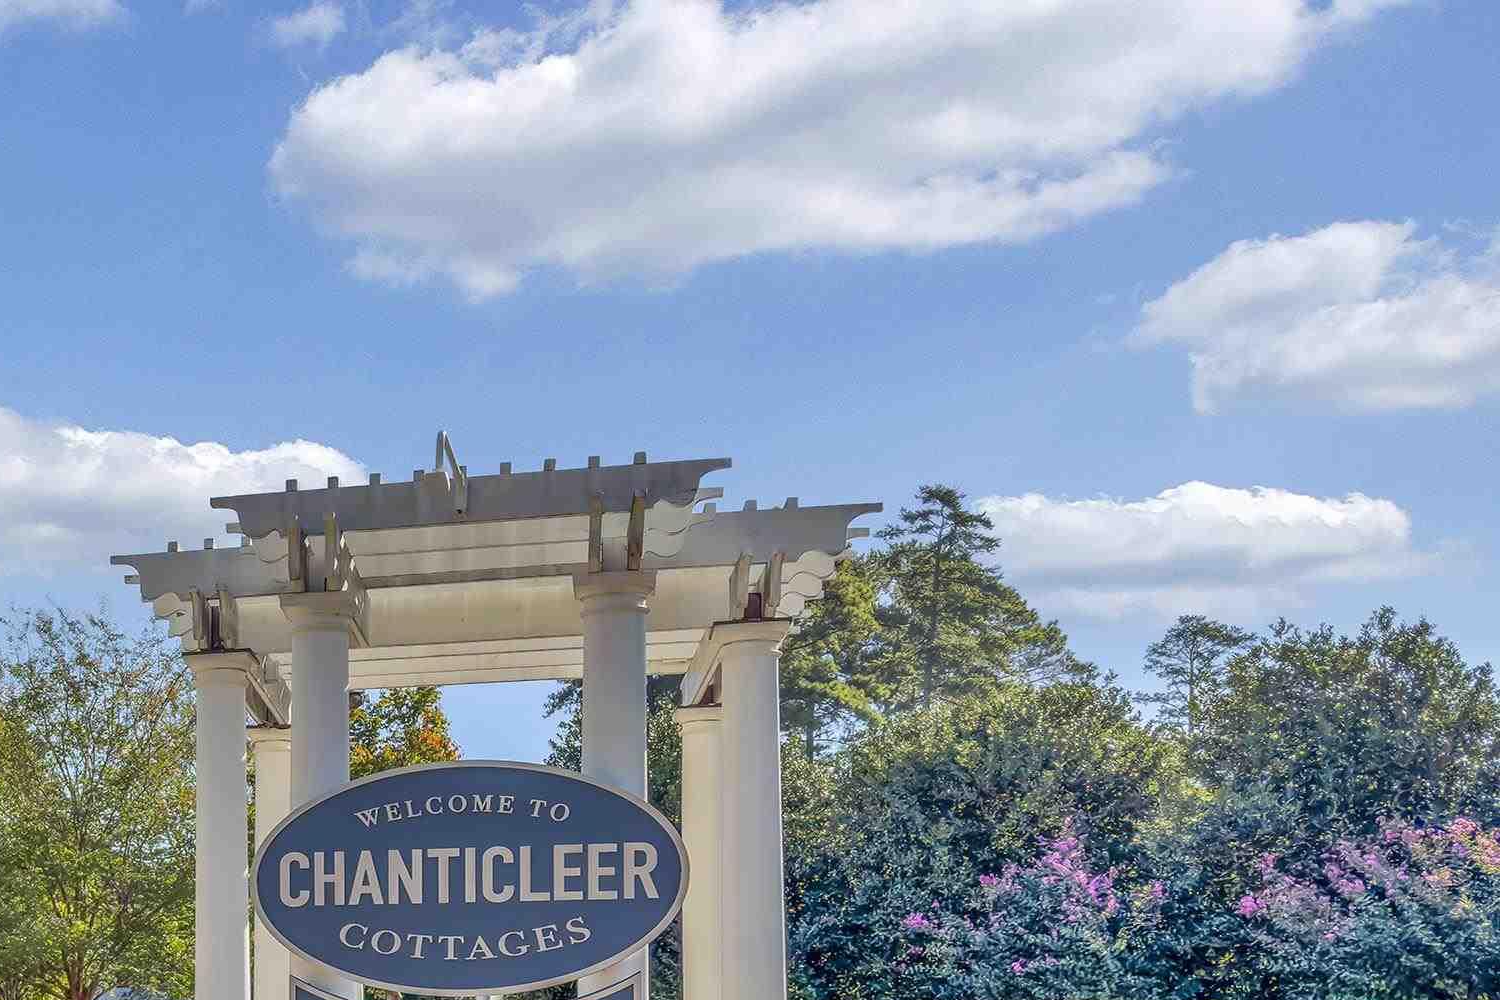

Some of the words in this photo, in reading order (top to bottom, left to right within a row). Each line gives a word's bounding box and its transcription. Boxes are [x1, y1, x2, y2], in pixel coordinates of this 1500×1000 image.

[353, 794, 515, 829] WELCOME
[529, 798, 571, 823] TO
[279, 841, 661, 908] CHANTICLEER
[338, 916, 592, 961] COTTAGES
